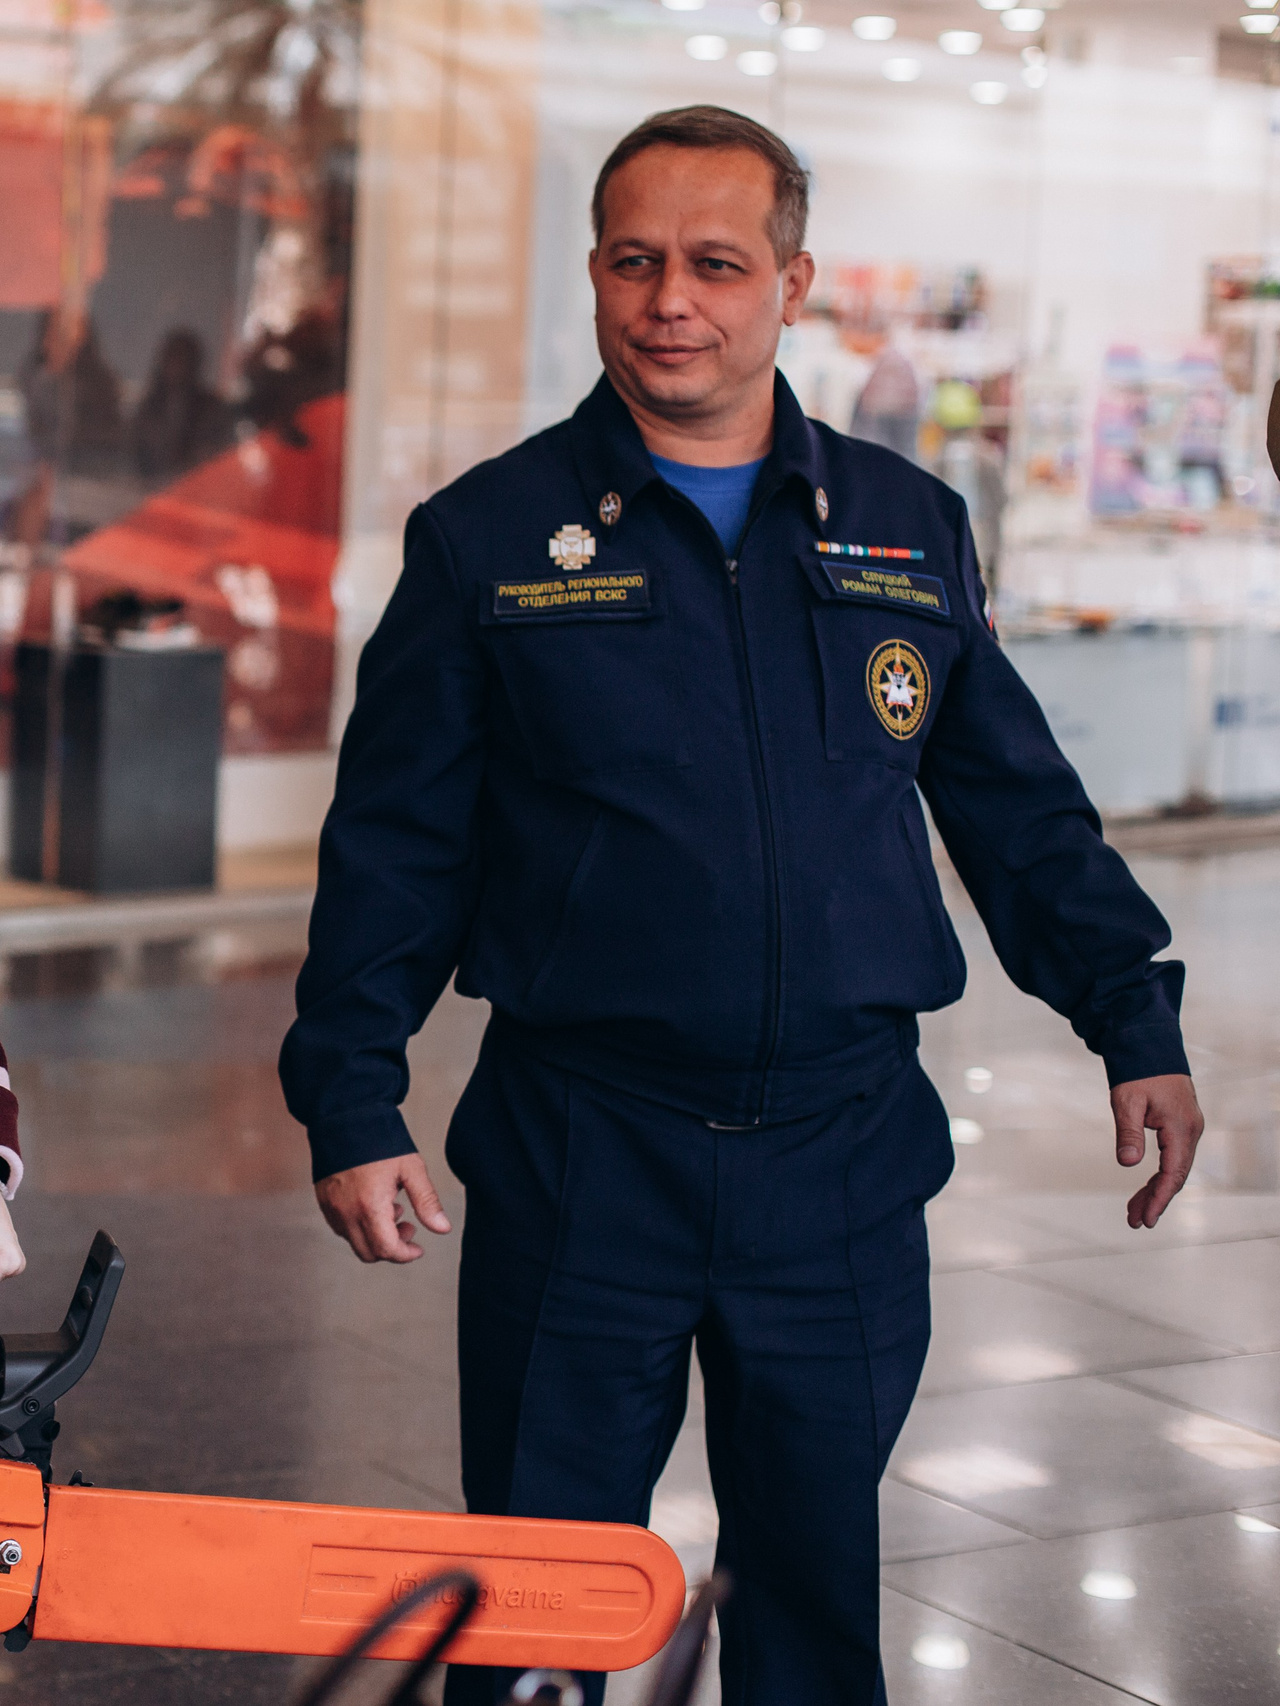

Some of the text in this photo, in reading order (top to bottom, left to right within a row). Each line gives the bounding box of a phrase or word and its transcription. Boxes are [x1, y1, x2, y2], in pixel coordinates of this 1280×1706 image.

[498, 575, 643, 596] РУКОВОДИТЕЛЬ РЕГИОНАЛЬНОГО
[841, 578, 939, 608] РОМАН ОЛЕГОВИЧ
[518, 589, 627, 607] ОТДЕЛЕНИЯ ВСКС
